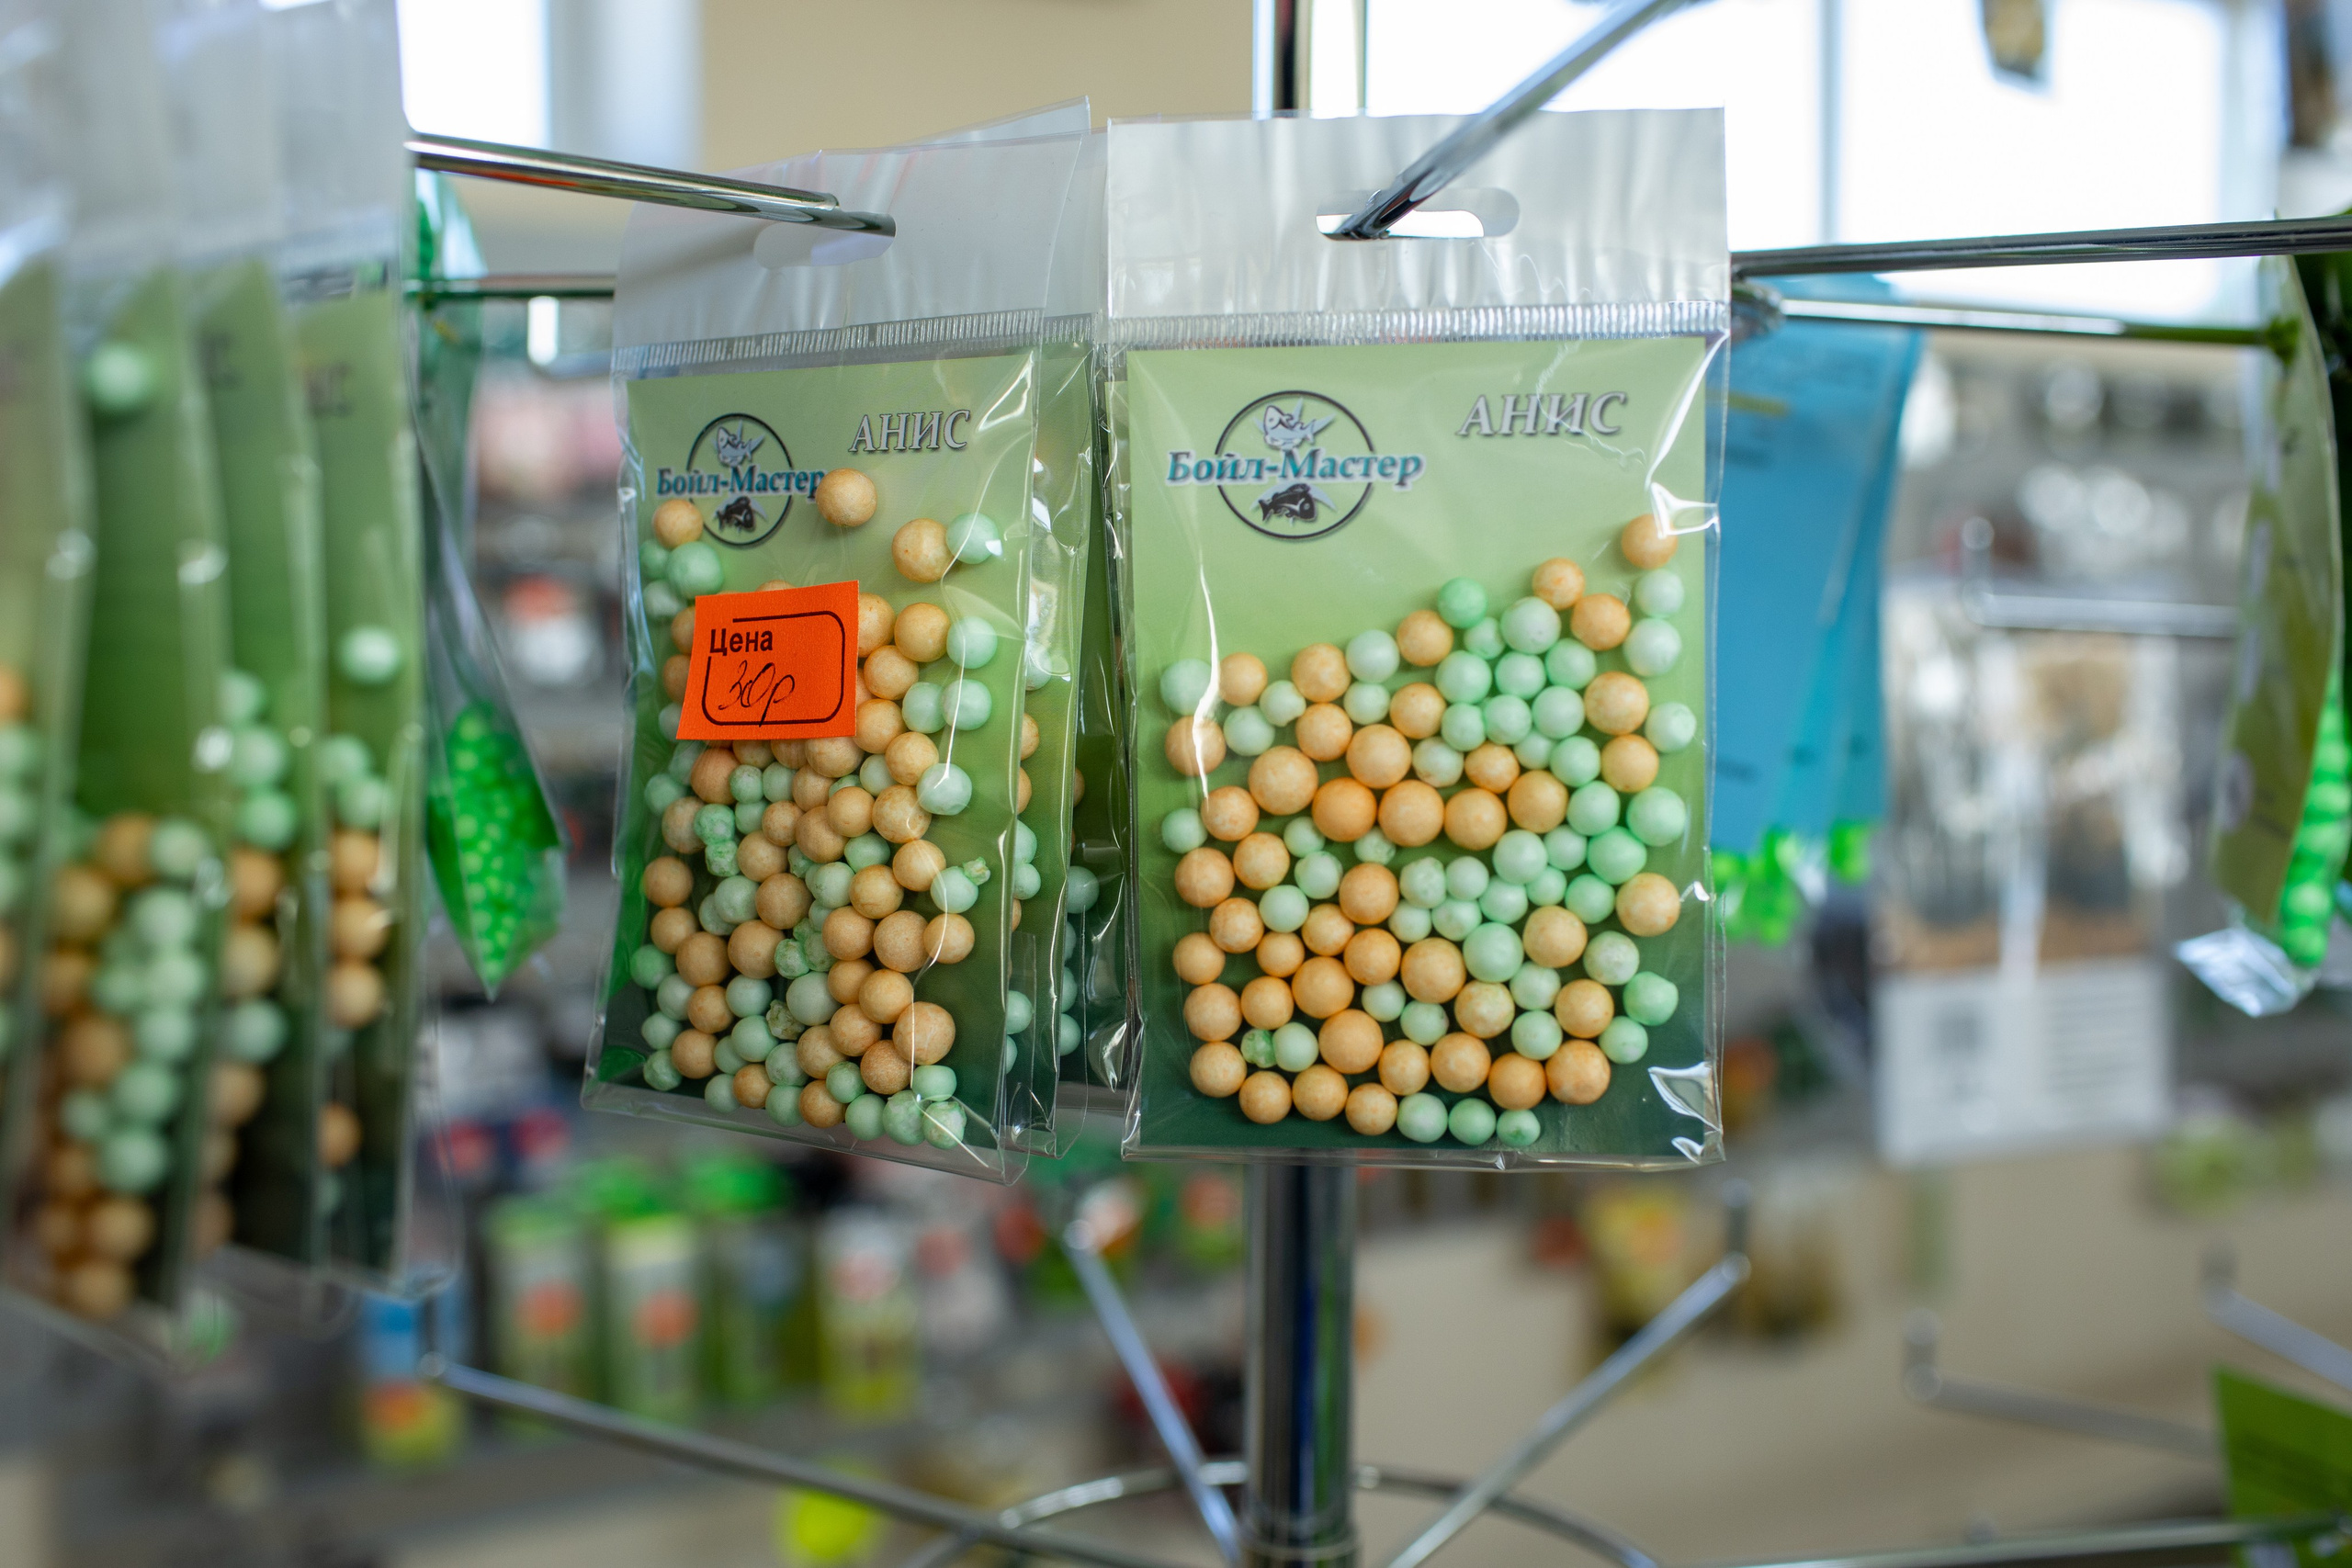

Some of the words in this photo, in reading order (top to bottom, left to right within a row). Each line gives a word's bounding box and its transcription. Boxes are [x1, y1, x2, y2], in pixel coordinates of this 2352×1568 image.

[848, 409, 971, 454] АНИС
[1455, 390, 1627, 437] АНИС
[656, 464, 826, 500] Бойл-Мастер
[1167, 448, 1422, 487] Бойл-Мастер
[709, 627, 774, 657] Цена
